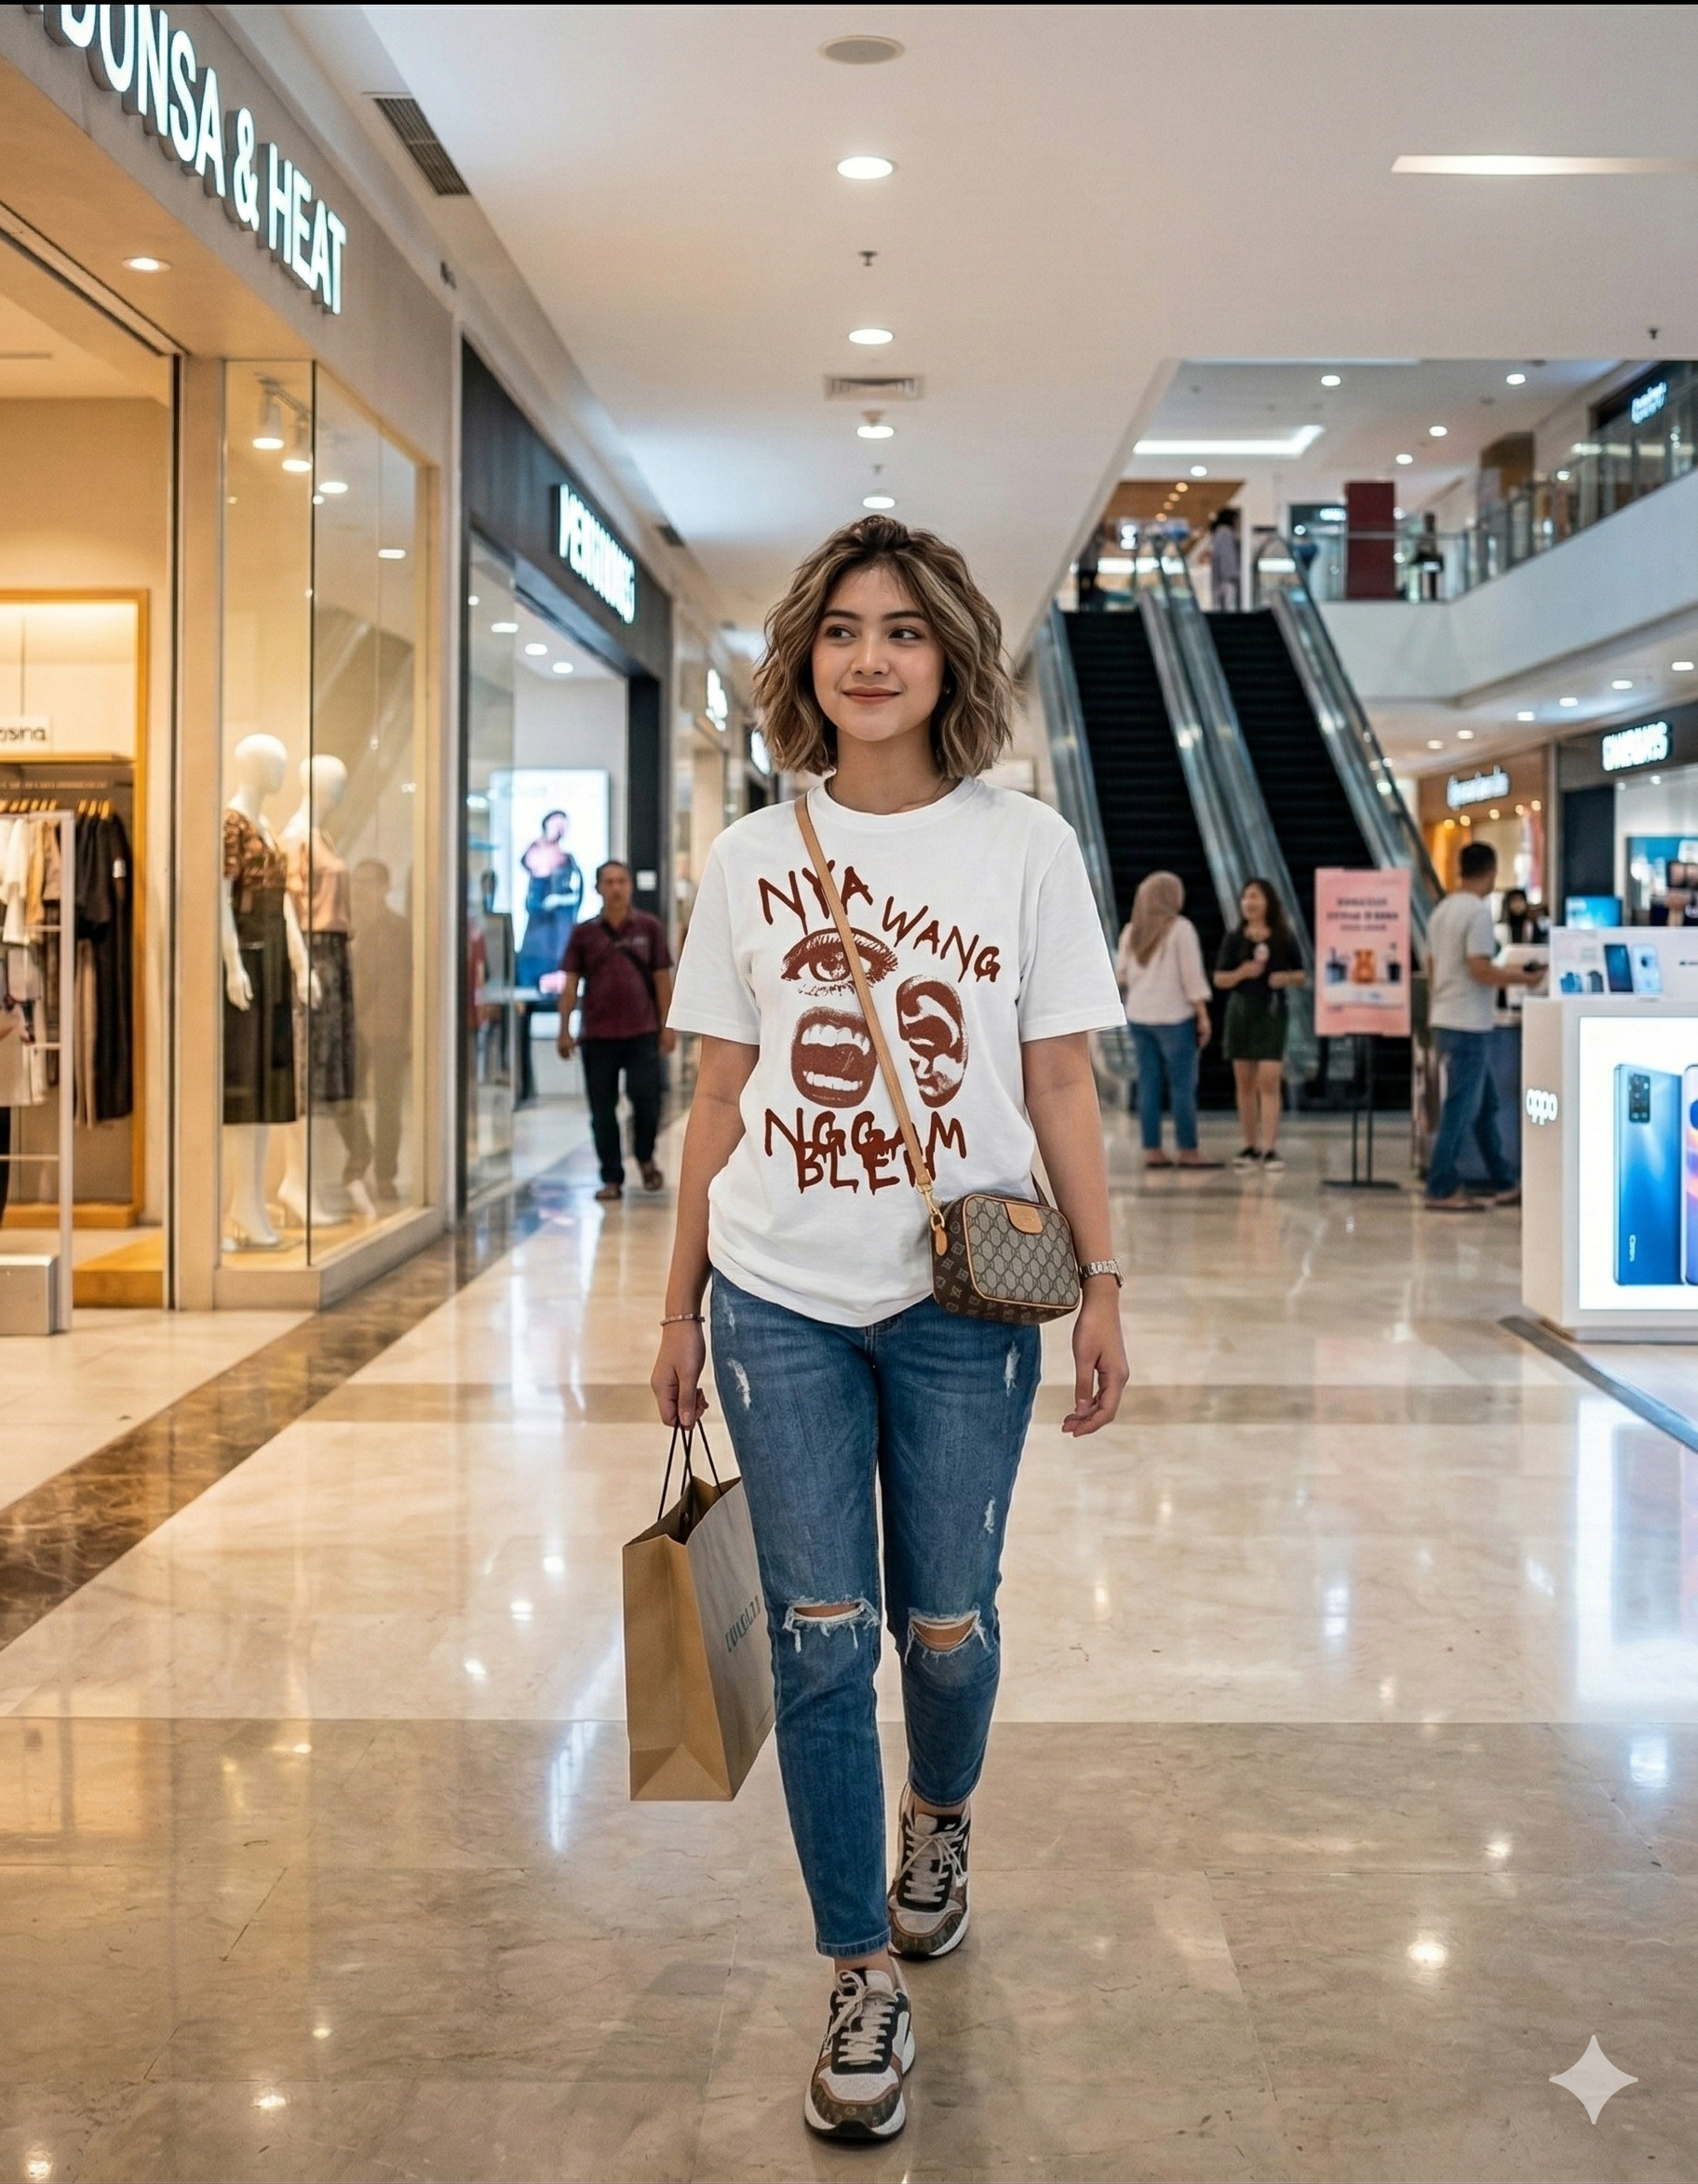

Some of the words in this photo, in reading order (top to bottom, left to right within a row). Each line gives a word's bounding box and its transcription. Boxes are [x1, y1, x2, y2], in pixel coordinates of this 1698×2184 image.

[234, 107, 260, 232] &
[269, 142, 347, 315] HEAT
[758, 859, 874, 936] NYA
[882, 896, 1002, 983] WANG
[764, 1107, 967, 1164] NGGAM
[1526, 1088, 1558, 1126] oppo
